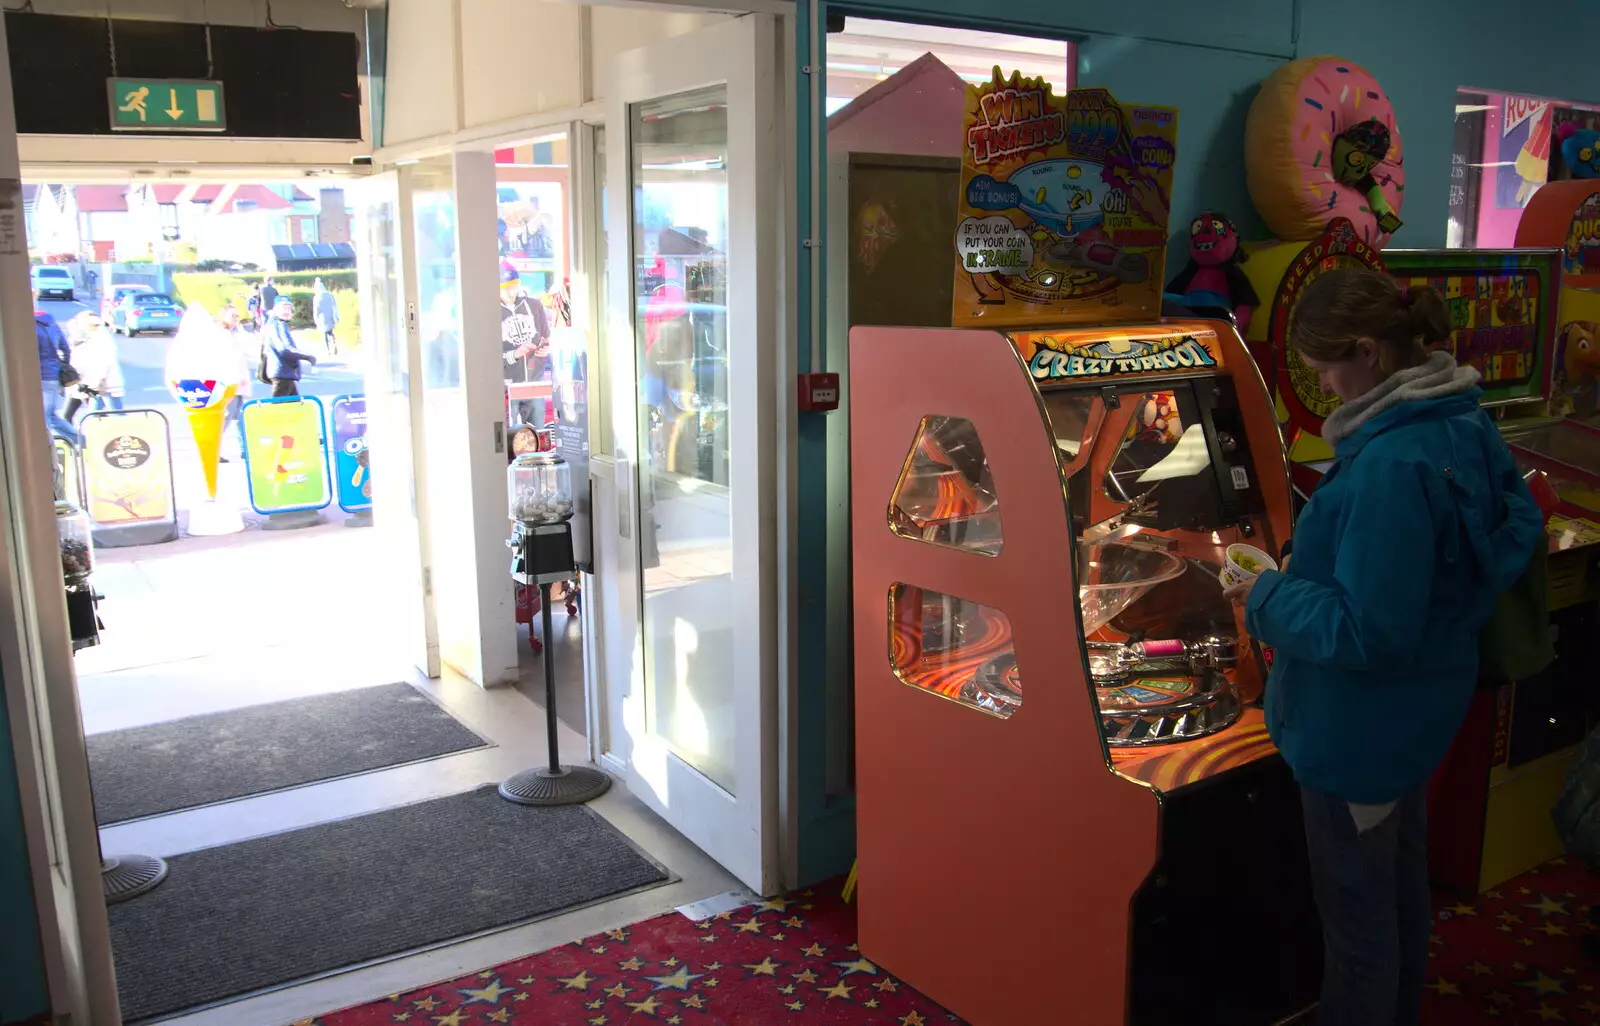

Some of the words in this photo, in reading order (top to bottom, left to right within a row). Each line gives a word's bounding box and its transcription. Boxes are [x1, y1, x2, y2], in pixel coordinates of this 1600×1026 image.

[983, 91, 1041, 126] WIN
[1067, 107, 1121, 149] 999
[975, 180, 990, 189] AIM
[969, 191, 985, 203] BIG
[987, 191, 1018, 205] BONUS!
[964, 224, 973, 235] IF
[975, 224, 992, 235] YOU
[994, 224, 1010, 235] CAN
[965, 237, 981, 248] PUT
[983, 237, 1004, 248] YOUR
[1006, 237, 1026, 248] COIN
[1029, 349, 1112, 380] CRAZY
[1115, 340, 1215, 374] TYPHOON
